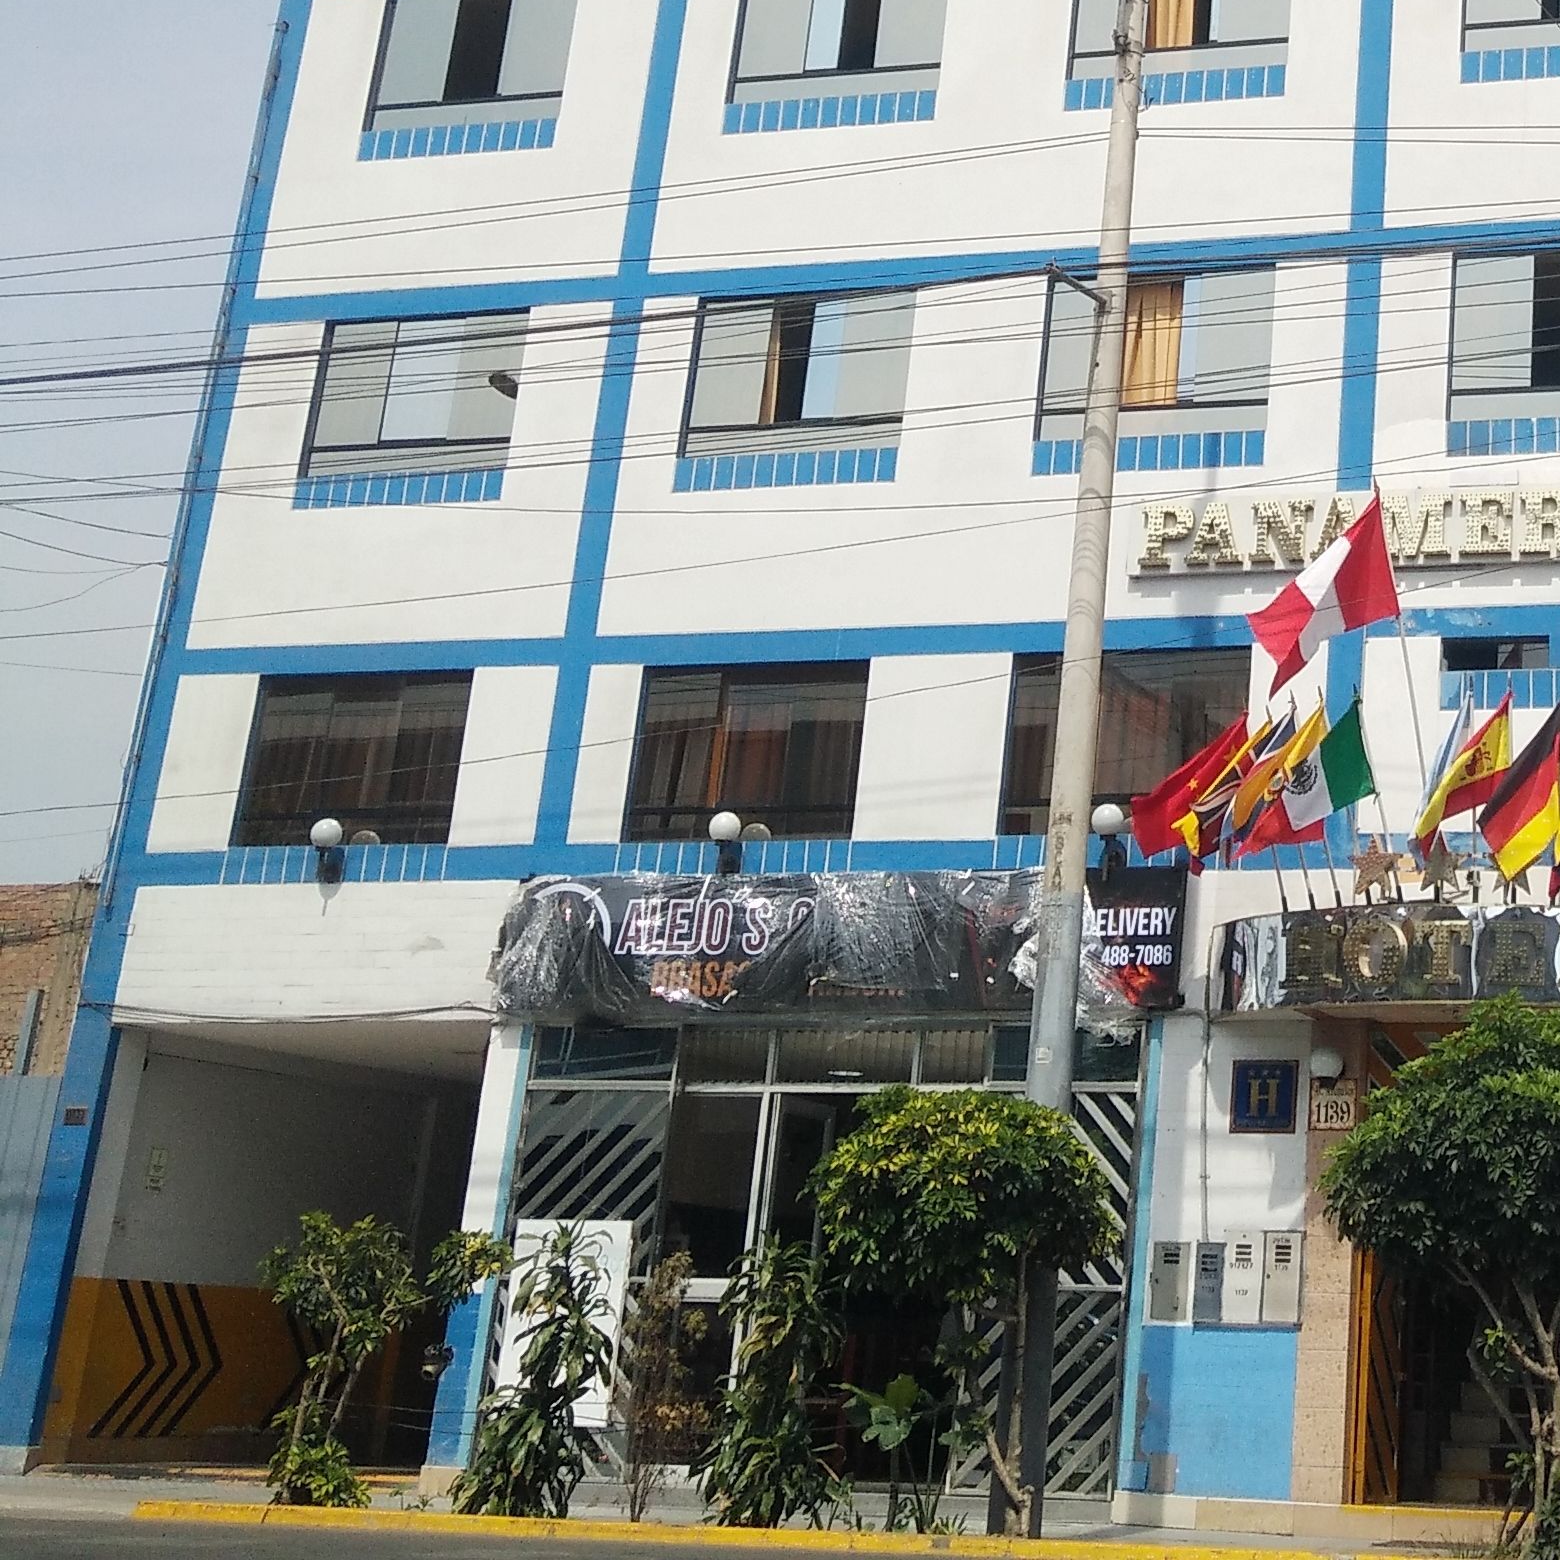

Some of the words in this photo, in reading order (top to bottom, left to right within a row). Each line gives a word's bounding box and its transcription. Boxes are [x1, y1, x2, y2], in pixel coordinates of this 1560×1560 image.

[1101, 943, 1173, 967] 488-7086
[1247, 1078, 1279, 1117] H
[1315, 1100, 1351, 1123] 1139
